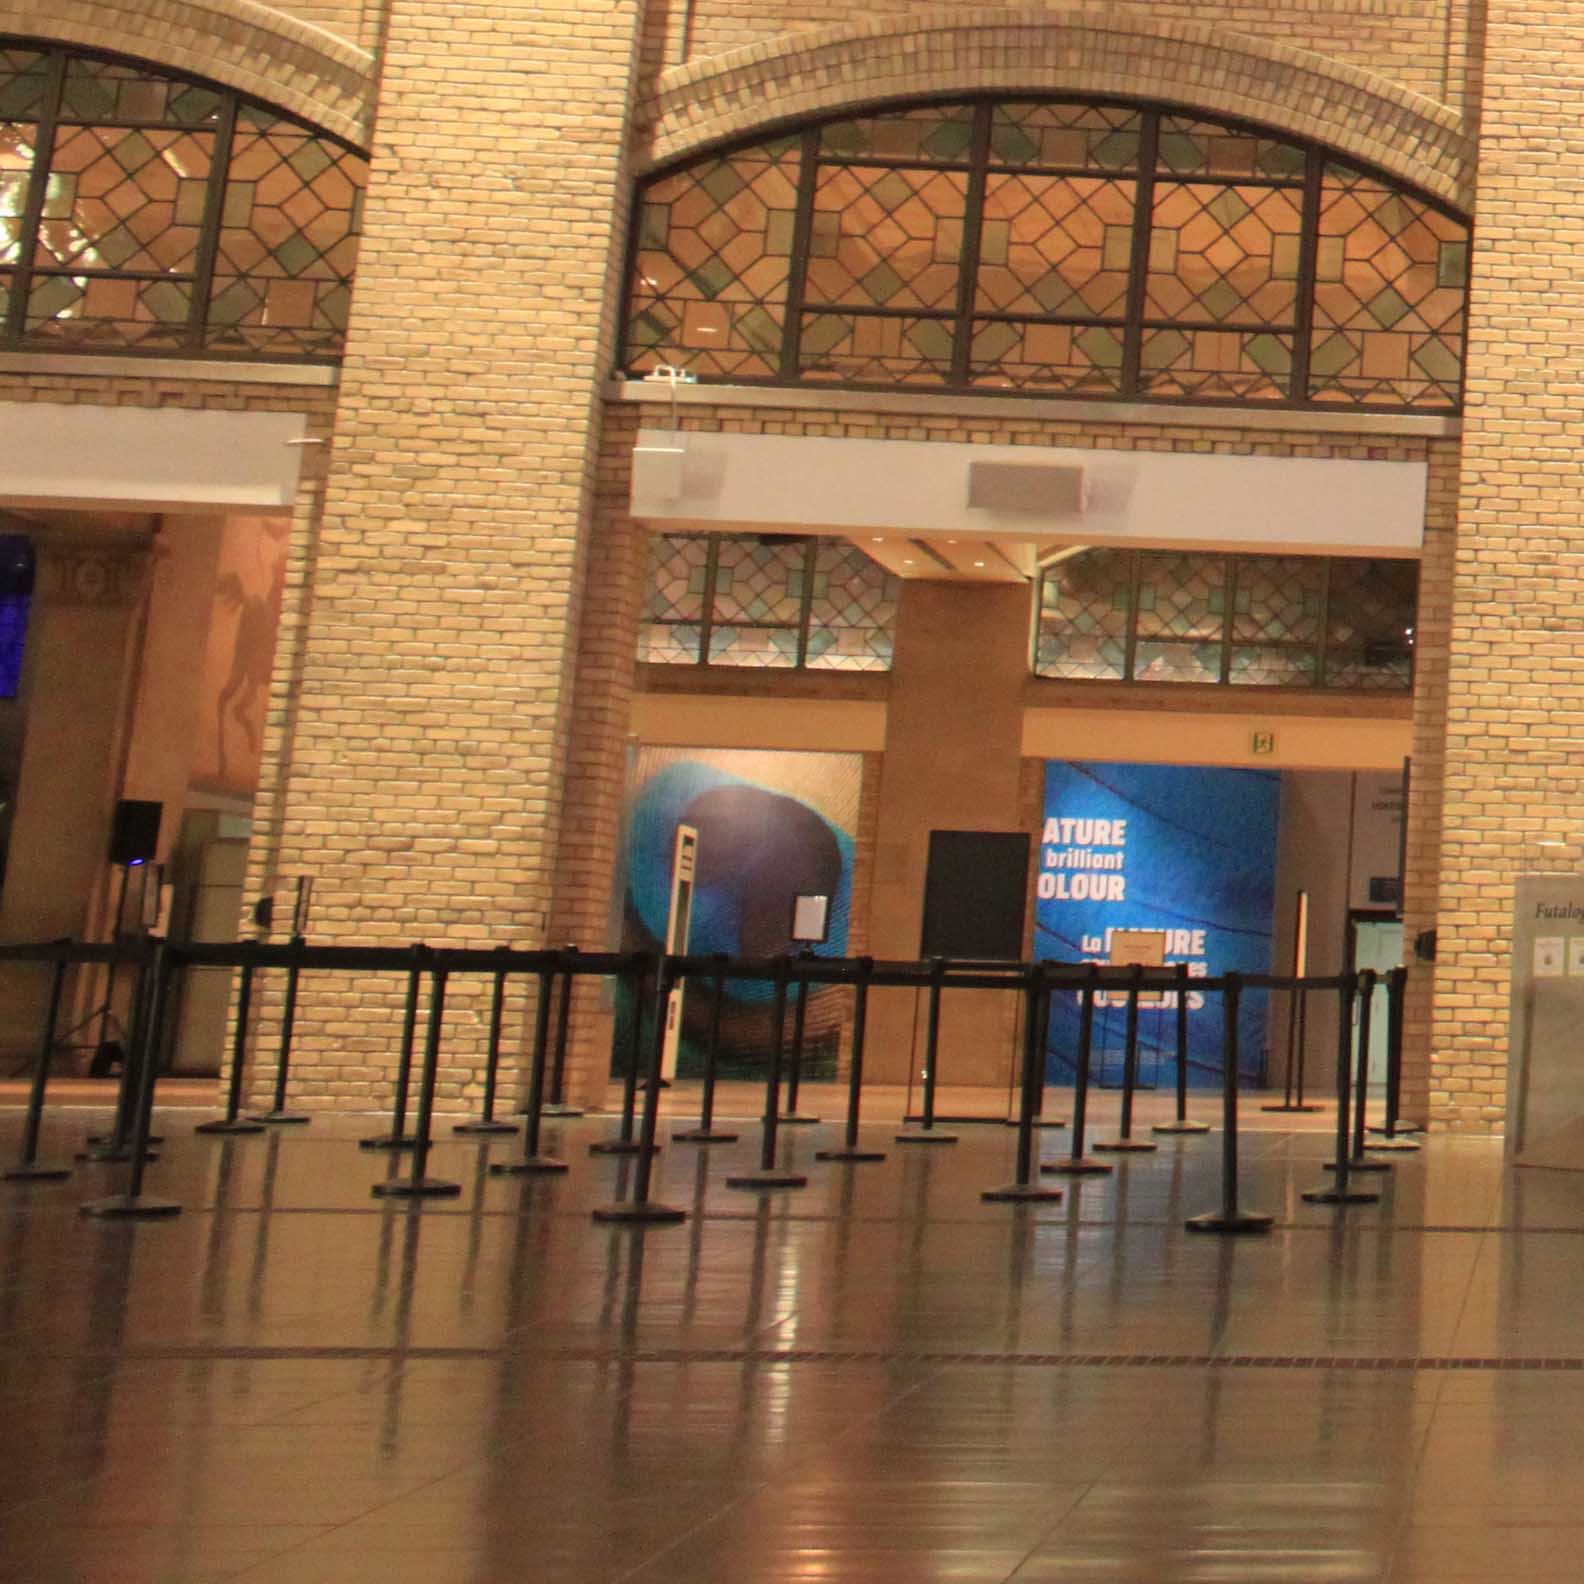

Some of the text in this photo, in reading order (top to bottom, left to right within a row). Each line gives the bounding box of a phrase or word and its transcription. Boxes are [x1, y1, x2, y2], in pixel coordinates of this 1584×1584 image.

[1042, 818, 1127, 846] ATURE
[1045, 848, 1125, 870] brilliant
[1037, 872, 1126, 901] OLOUR
[1081, 935, 1102, 953] La
